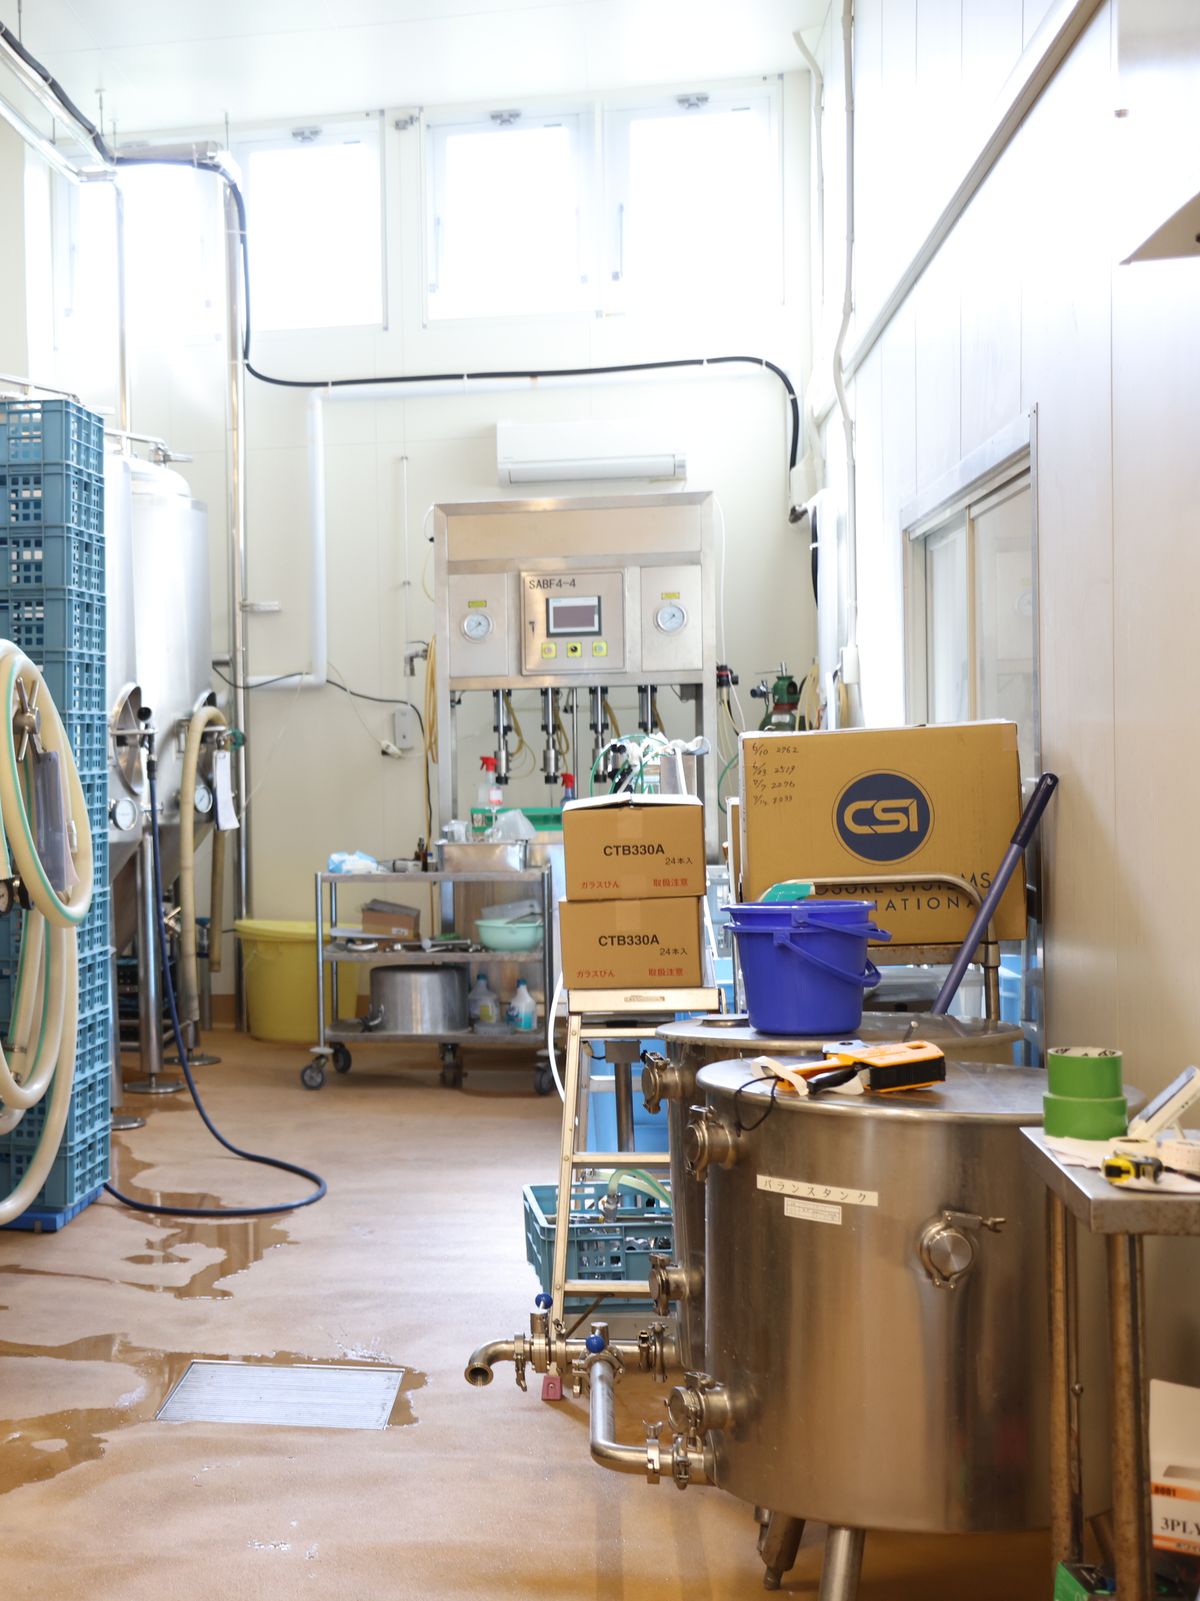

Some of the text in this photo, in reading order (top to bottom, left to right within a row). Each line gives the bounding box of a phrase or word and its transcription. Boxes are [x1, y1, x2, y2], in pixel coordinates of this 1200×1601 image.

[529, 578, 576, 590] SABF4-4
[843, 798, 919, 835] CSI
[603, 844, 665, 857] CTB330A
[665, 857, 693, 865] 24本入
[581, 881, 620, 889] ガラスびん
[653, 878, 689, 887] 取扱注意
[598, 934, 660, 947] CTB330A
[659, 947, 688, 956] 24本入
[576, 969, 616, 978] ガラスびん
[648, 967, 684, 977] 取扱注意
[764, 1179, 867, 1203] バランスタンク
